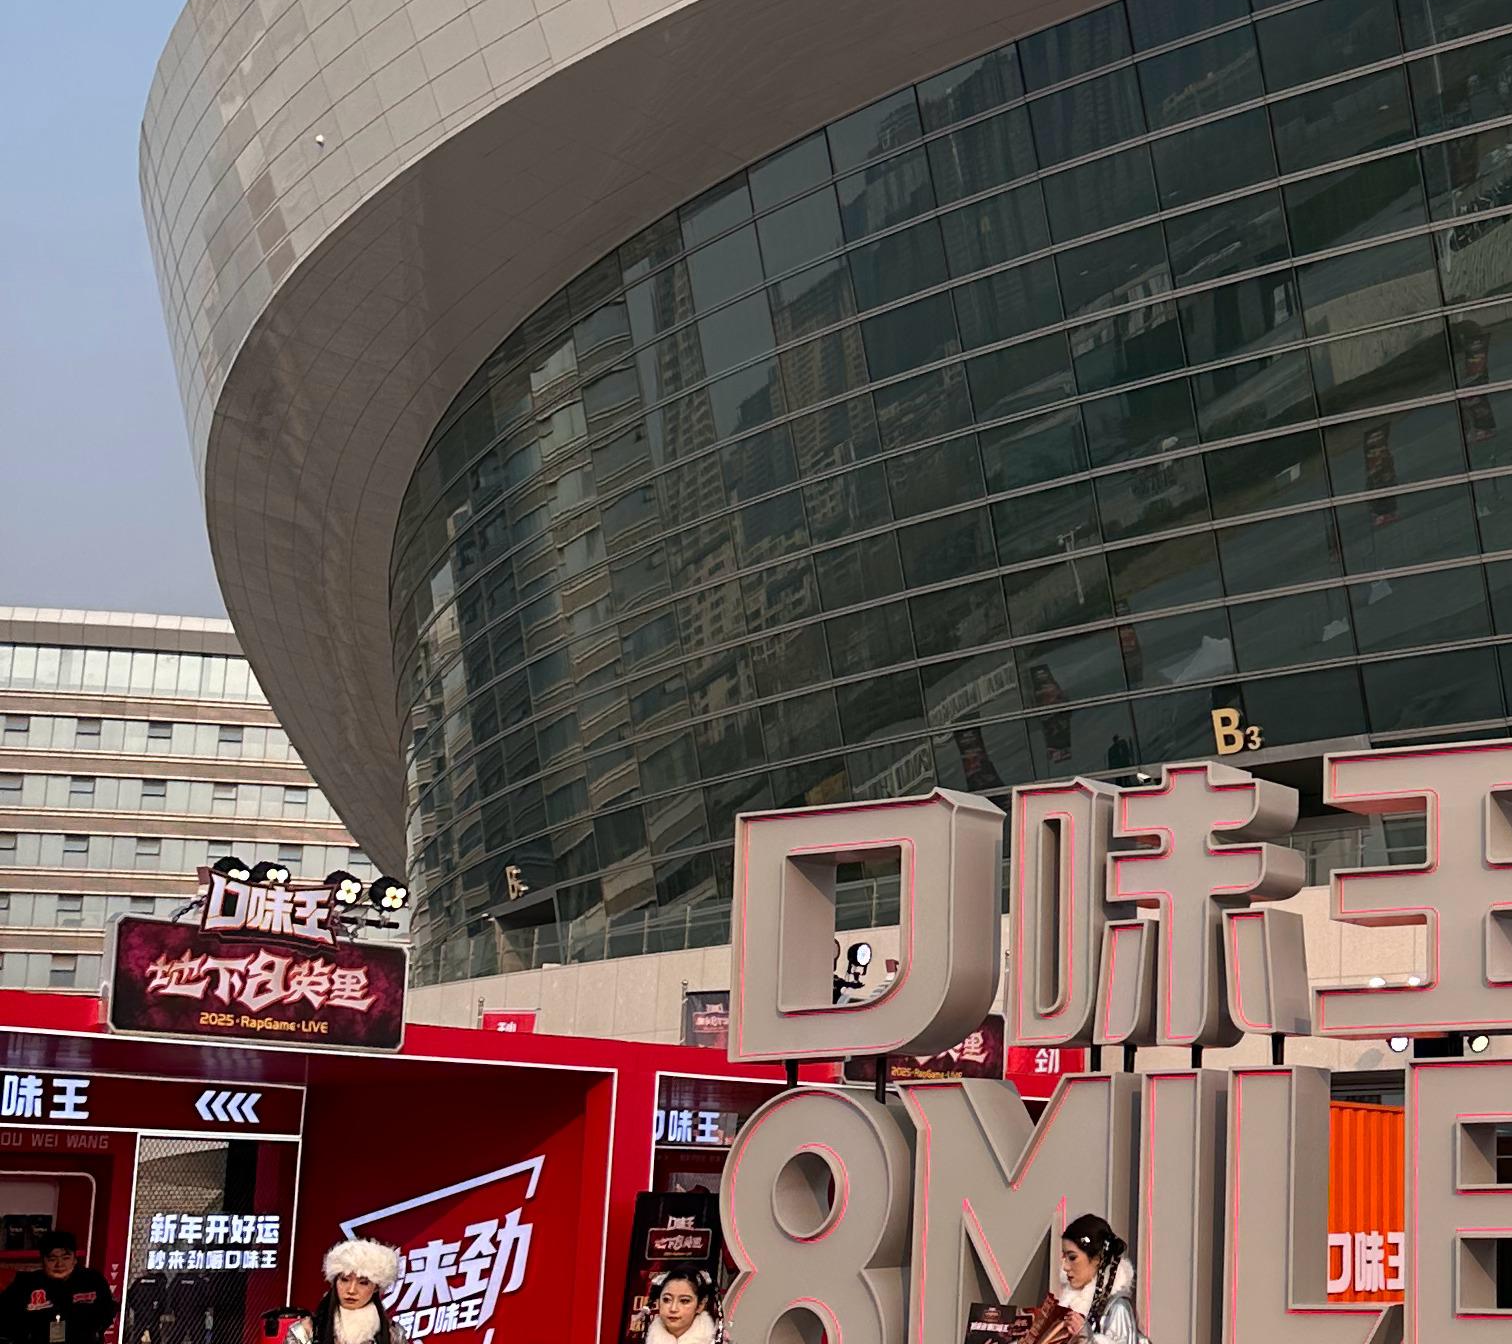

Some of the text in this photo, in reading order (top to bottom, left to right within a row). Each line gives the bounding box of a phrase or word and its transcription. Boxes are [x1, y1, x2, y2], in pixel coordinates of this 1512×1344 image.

[1211, 707, 1263, 754] B3
[204, 873, 337, 944] 口味王
[31, 1133, 59, 1148] WEI
[66, 1135, 109, 1149] WANG
[150, 1213, 280, 1244] 新年开好运
